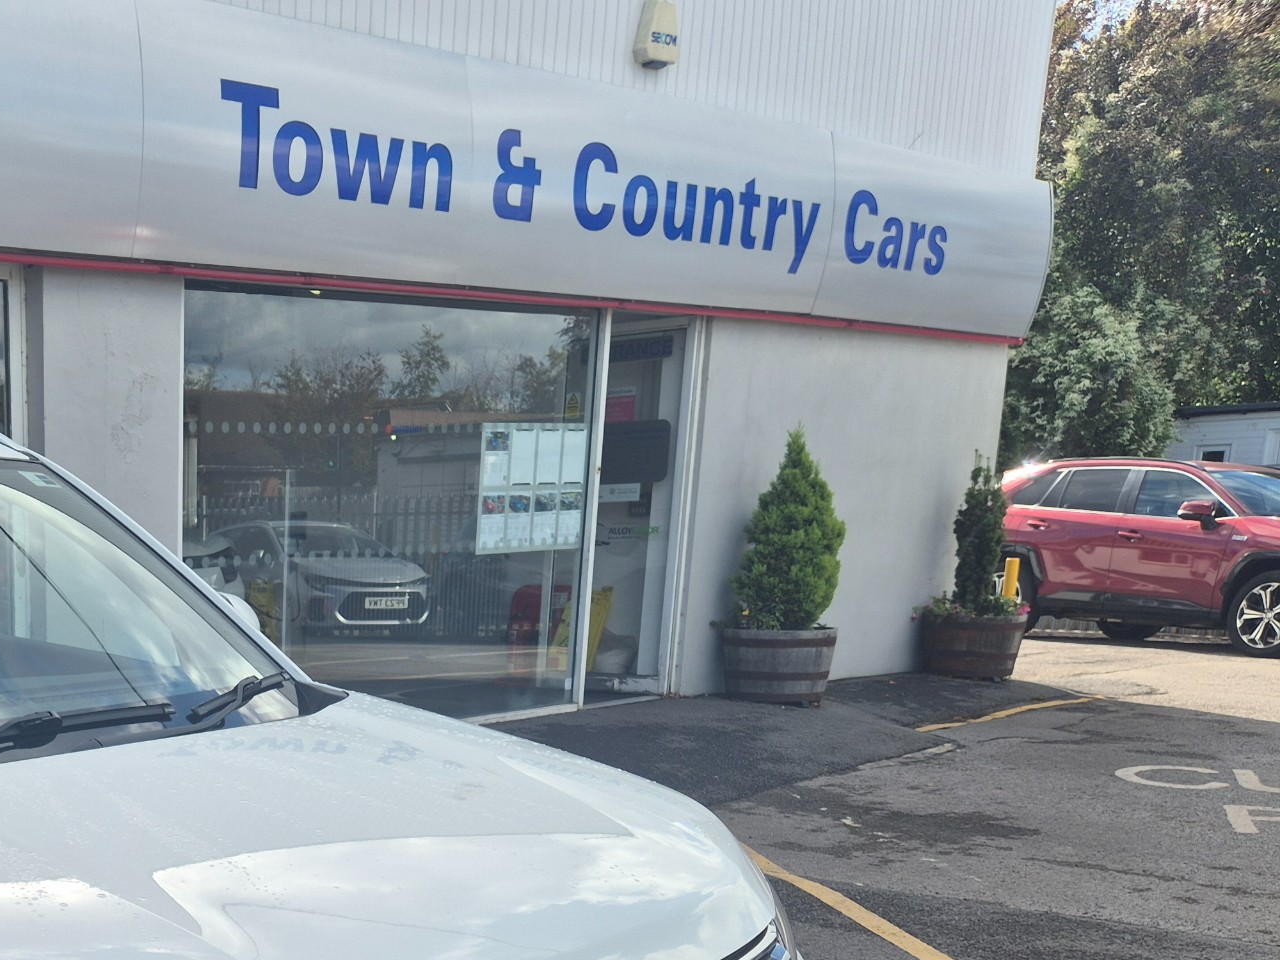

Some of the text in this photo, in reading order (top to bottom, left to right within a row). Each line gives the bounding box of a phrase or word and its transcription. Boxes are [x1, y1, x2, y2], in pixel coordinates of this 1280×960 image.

[651, 31, 677, 47] SECOM
[219, 78, 949, 276] Town & Country Cars
